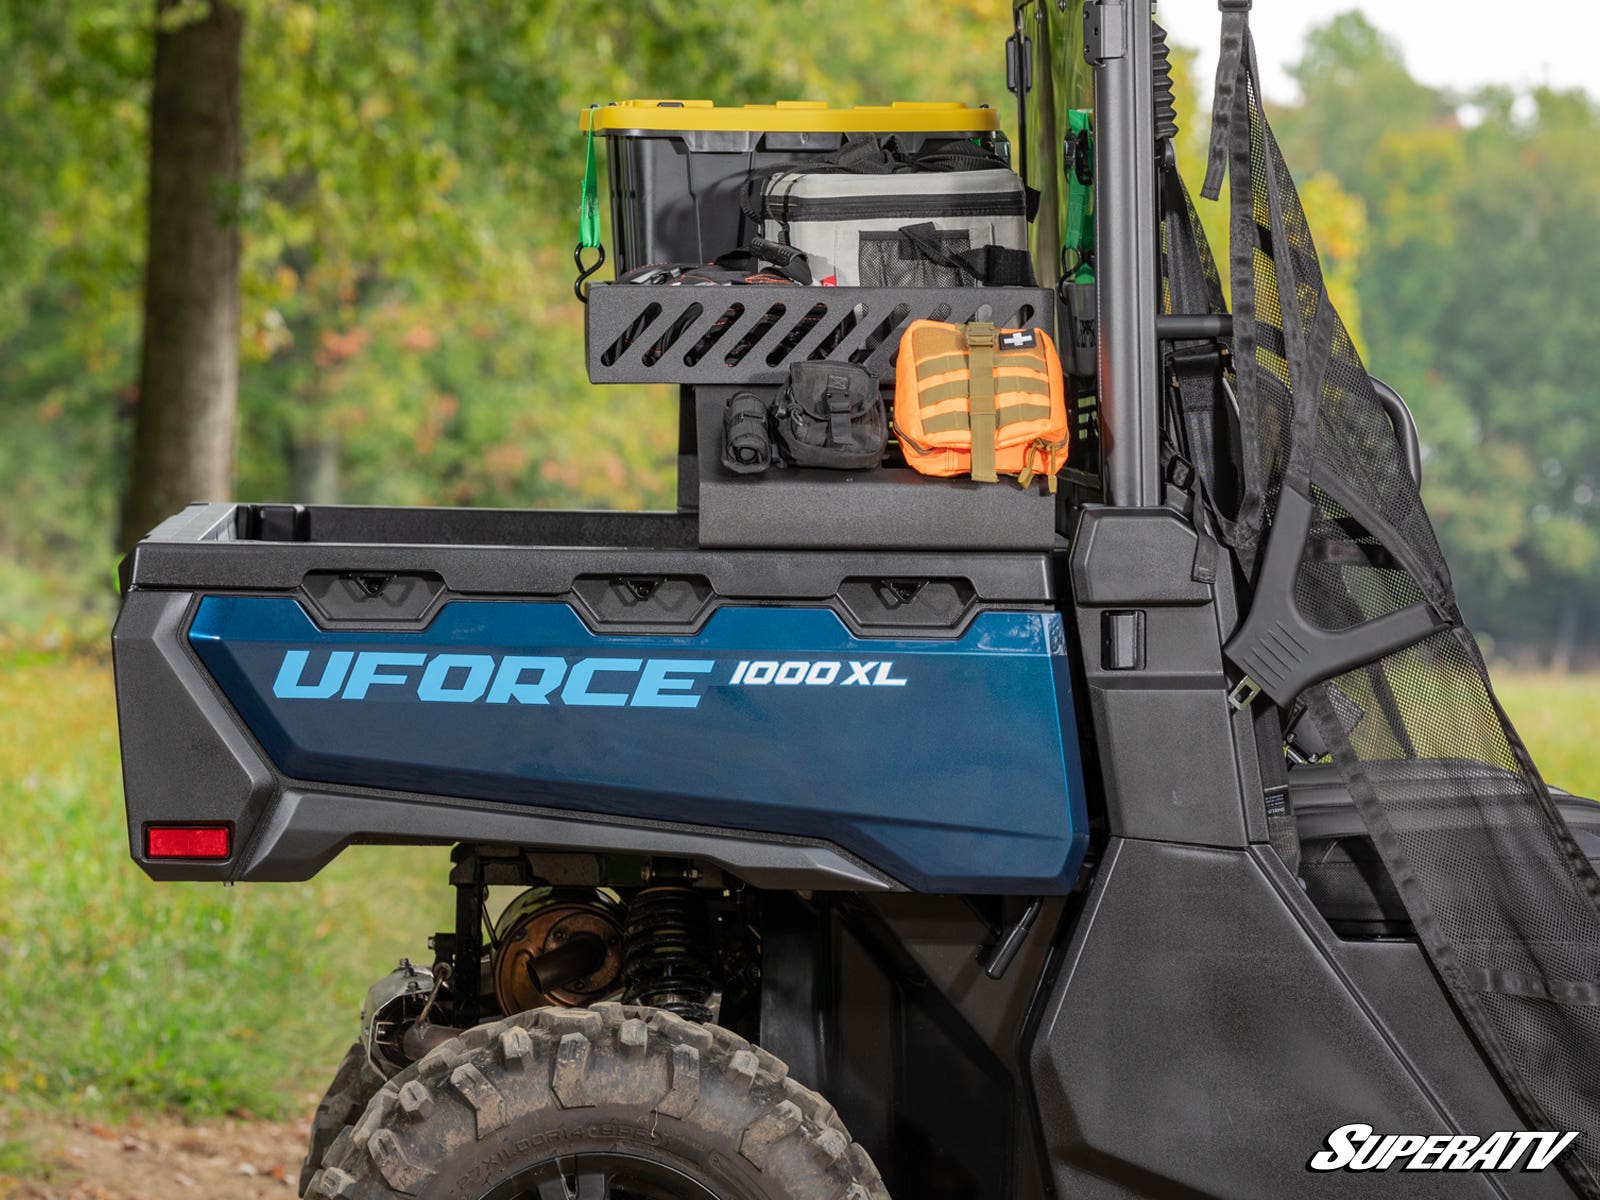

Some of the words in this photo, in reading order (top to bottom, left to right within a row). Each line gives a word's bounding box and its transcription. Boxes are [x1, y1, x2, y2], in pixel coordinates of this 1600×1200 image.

[272, 650, 715, 708] UFORCE
[728, 660, 842, 686] 1000
[840, 661, 908, 687] XL
